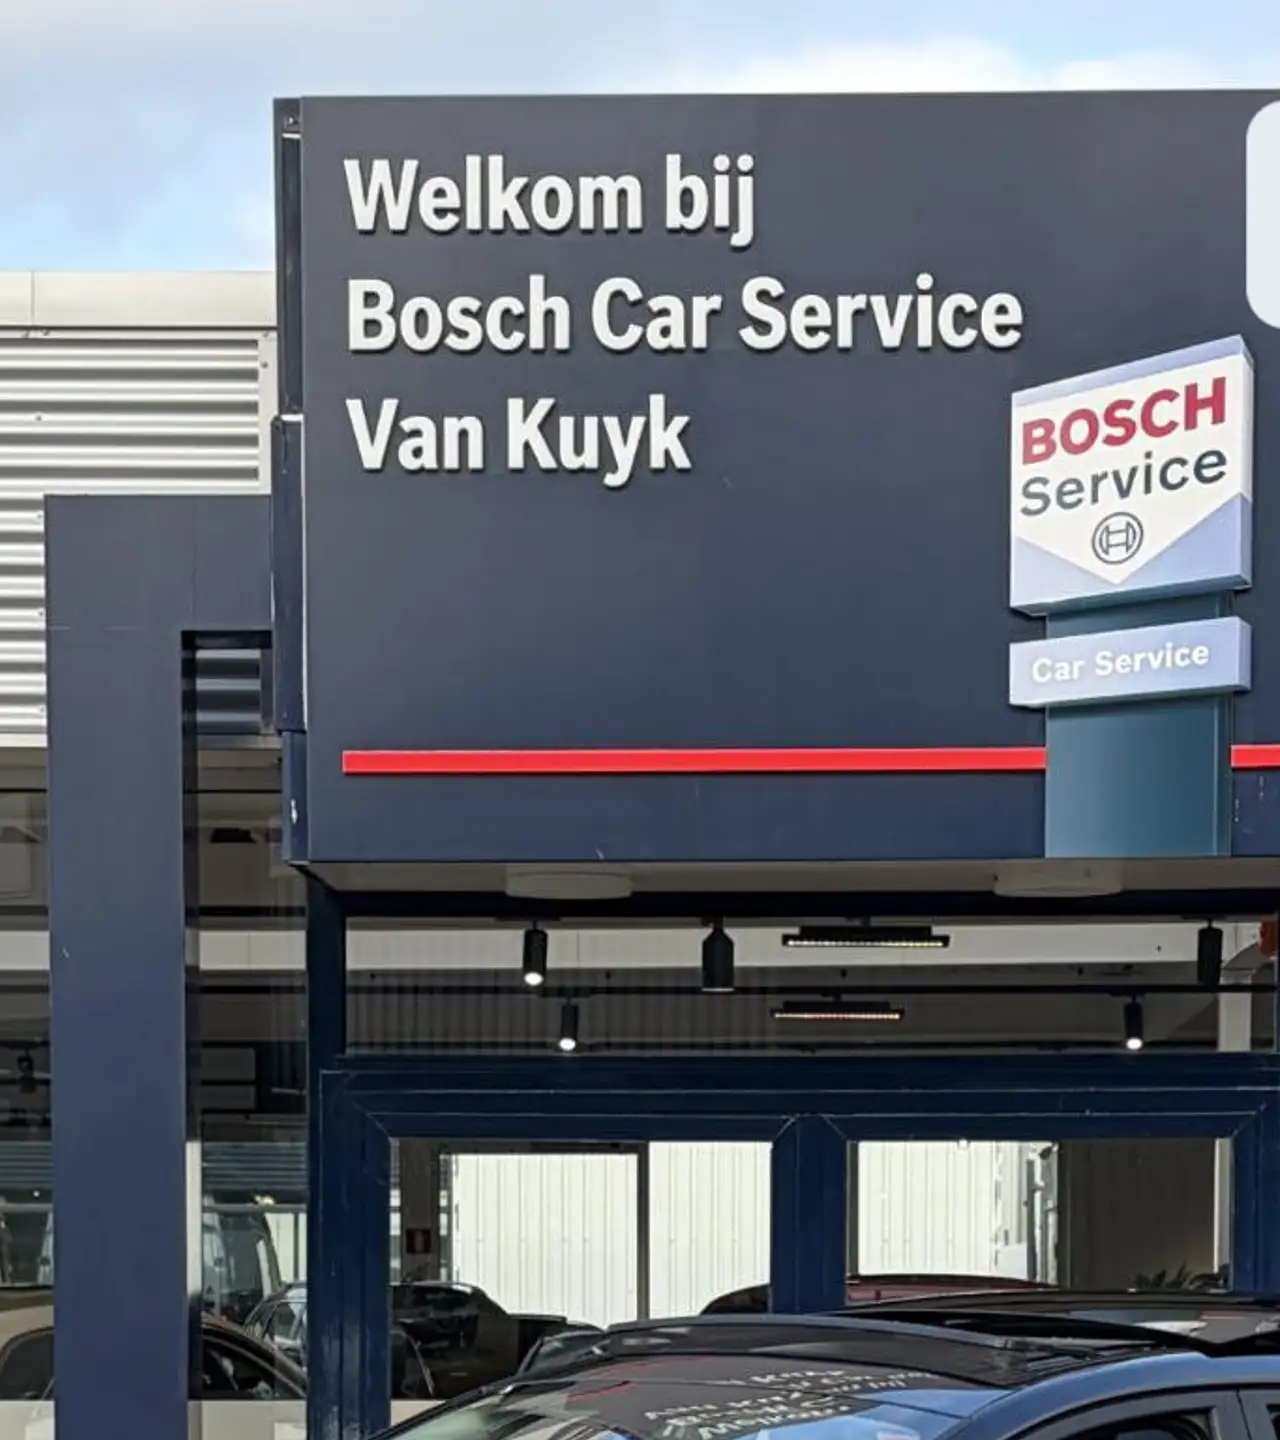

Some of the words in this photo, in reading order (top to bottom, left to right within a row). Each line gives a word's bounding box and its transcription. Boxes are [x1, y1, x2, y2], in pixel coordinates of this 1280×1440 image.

[342, 153, 643, 233] Welkom
[665, 152, 756, 249] bij
[347, 273, 571, 352] Bosch
[590, 275, 723, 352] Car
[738, 272, 1025, 351] Service
[344, 397, 485, 472] Van
[506, 392, 692, 489] Kuyk
[1022, 376, 1226, 465] BOSCH
[1019, 449, 1228, 518] Service
[1032, 658, 1085, 683] Car
[1095, 641, 1210, 677] Service
